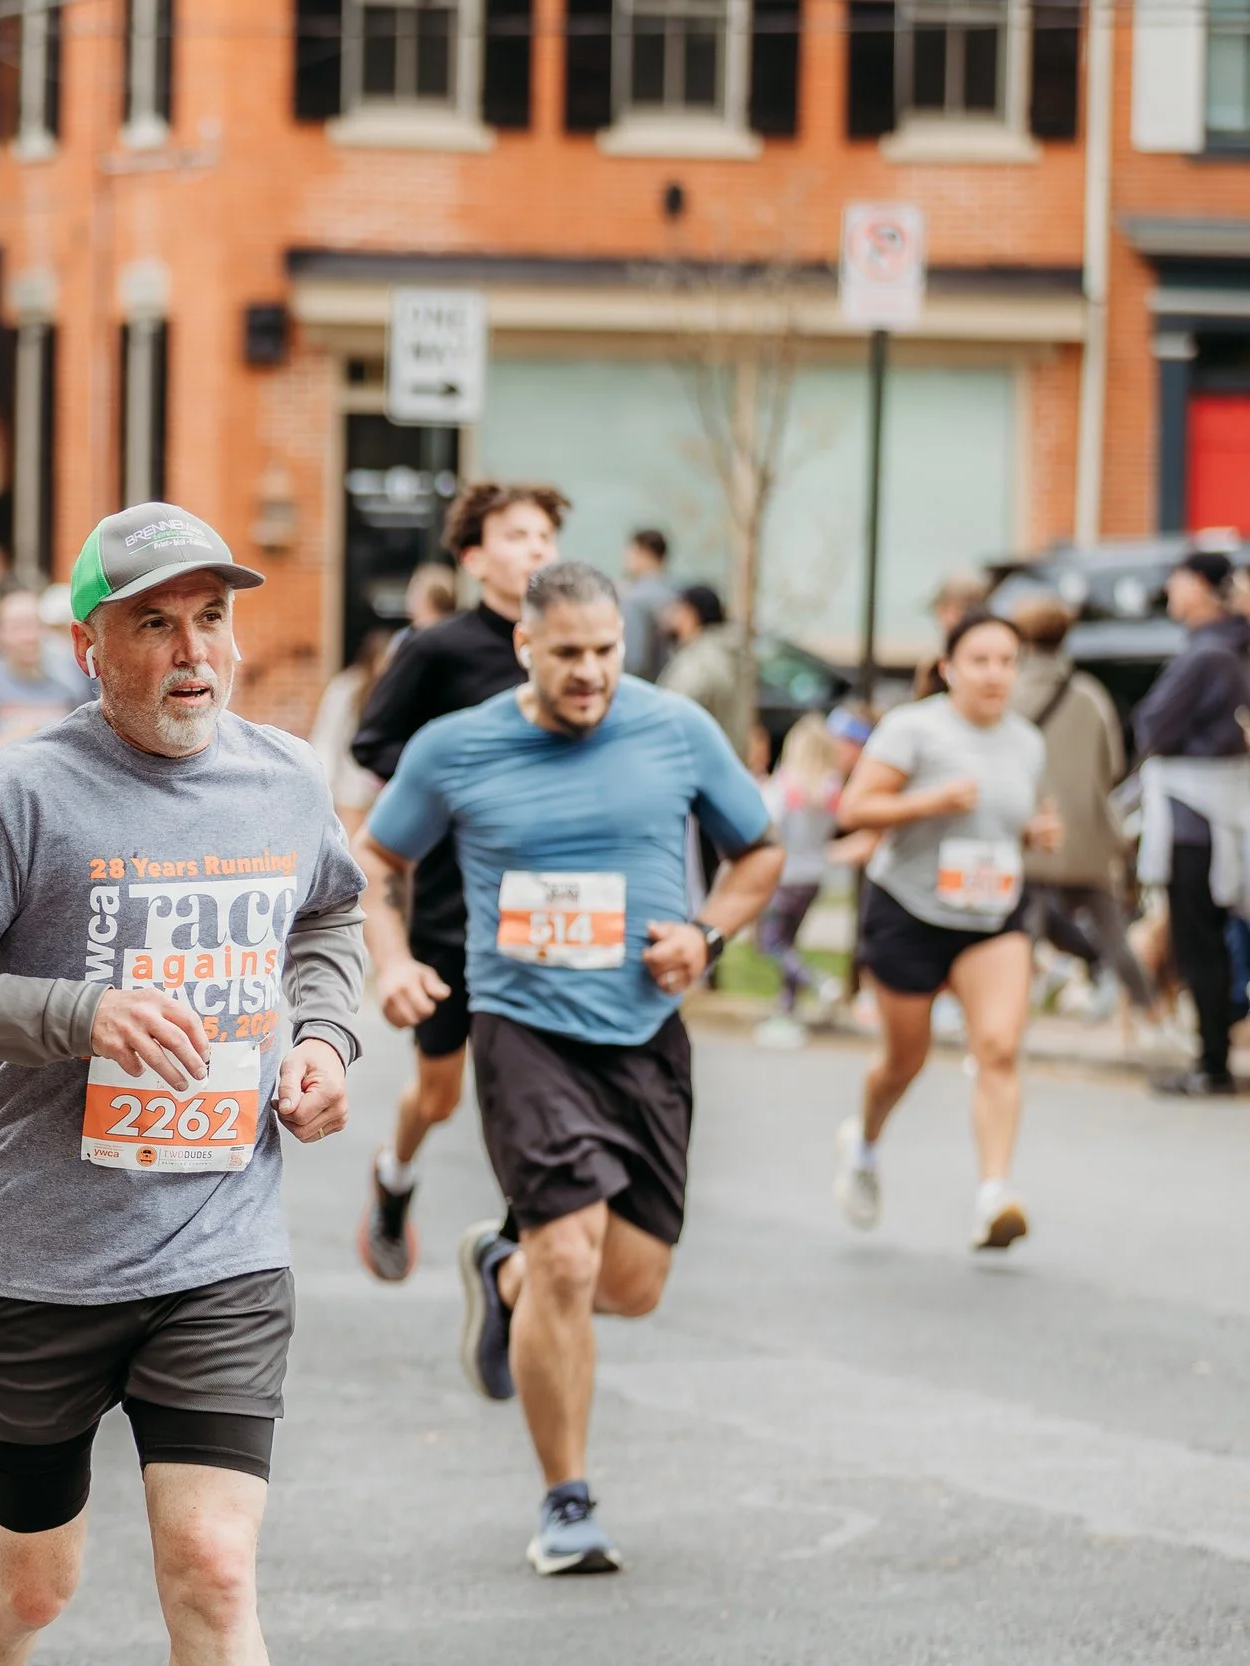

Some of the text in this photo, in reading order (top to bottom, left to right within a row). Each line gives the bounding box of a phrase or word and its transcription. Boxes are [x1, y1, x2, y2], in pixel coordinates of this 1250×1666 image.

[89, 851, 298, 880] 28 Years Running!
[84, 885, 120, 982] wca
[528, 911, 595, 945] 514
[131, 945, 278, 989] agains
[105, 1093, 241, 1141] 2262
[94, 1147, 120, 1158] ywca
